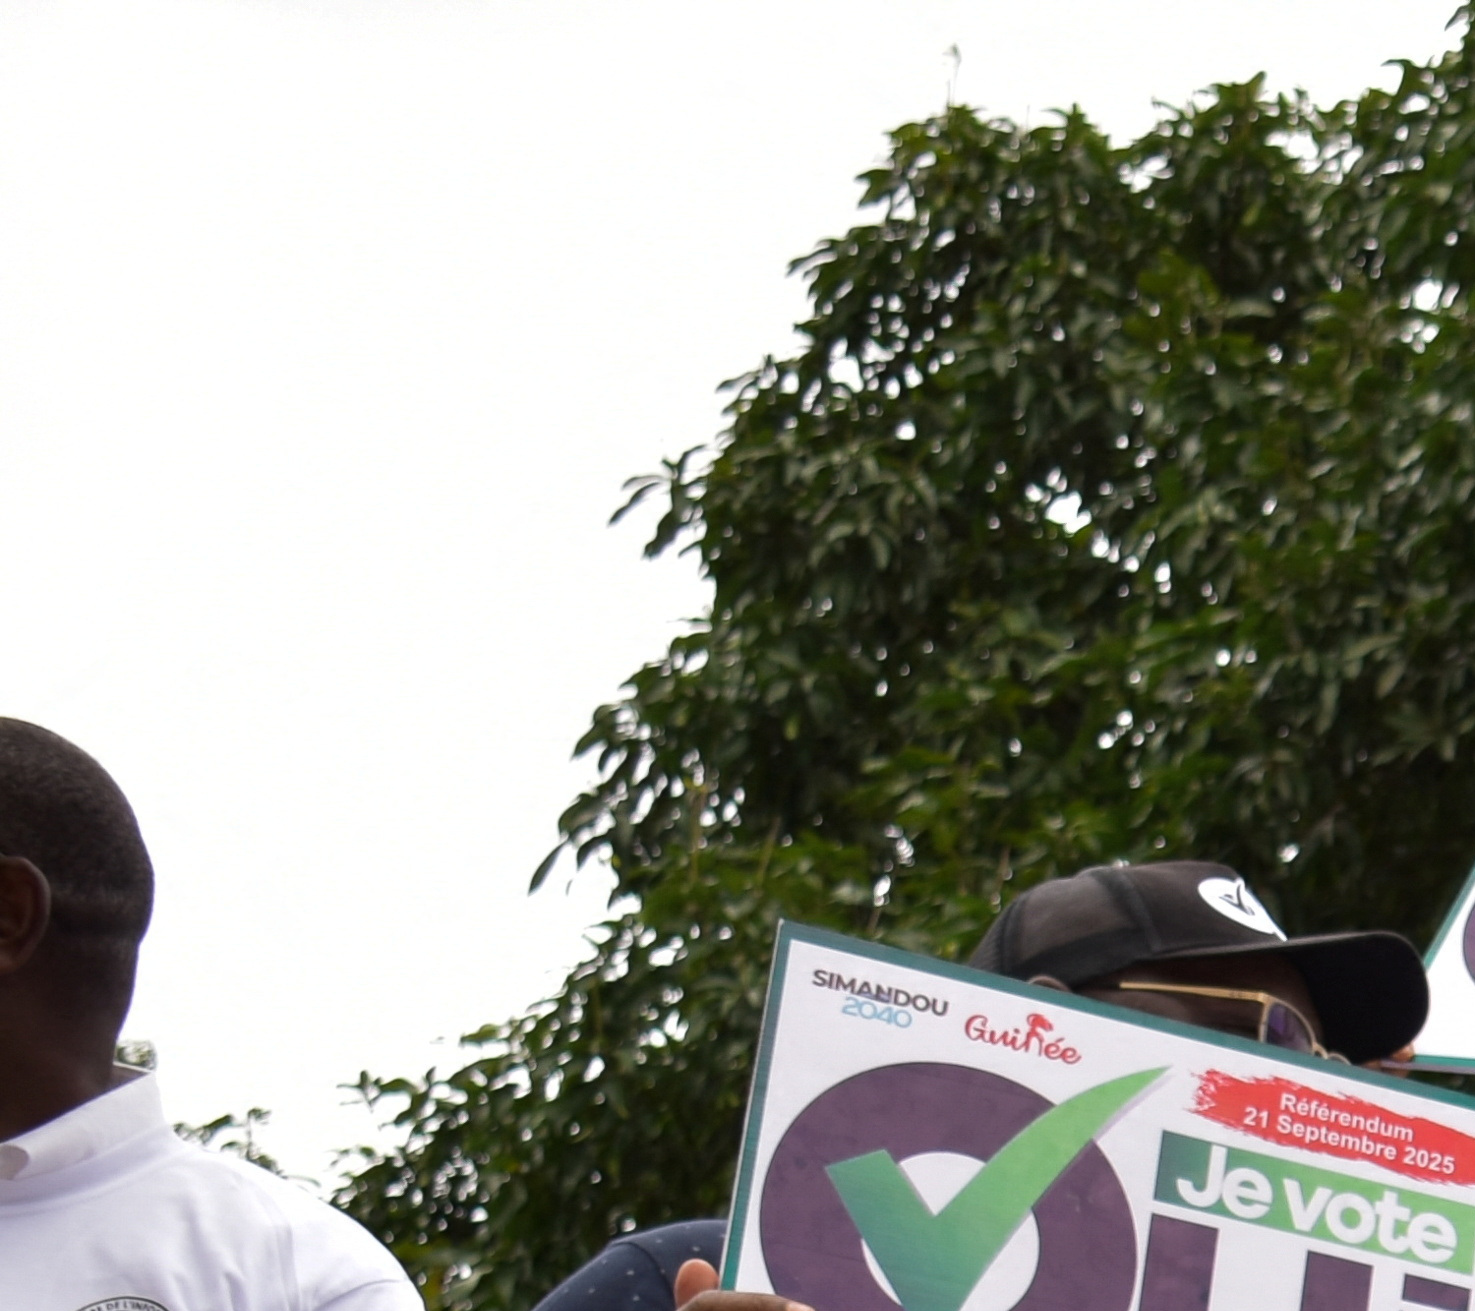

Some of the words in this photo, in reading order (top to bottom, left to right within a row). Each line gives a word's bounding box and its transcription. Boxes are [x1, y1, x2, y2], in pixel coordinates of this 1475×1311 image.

[811, 968, 950, 1017] SIMANDOU
[841, 996, 913, 1029] 2040
[1243, 1107, 1269, 1128] 21
[1276, 1114, 1398, 1161] Septembre
[1402, 1146, 1456, 1175] 2025
[1279, 1092, 1414, 1142] Référendum
[1176, 1144, 1273, 1220] Je
[1282, 1177, 1459, 1264] vote
